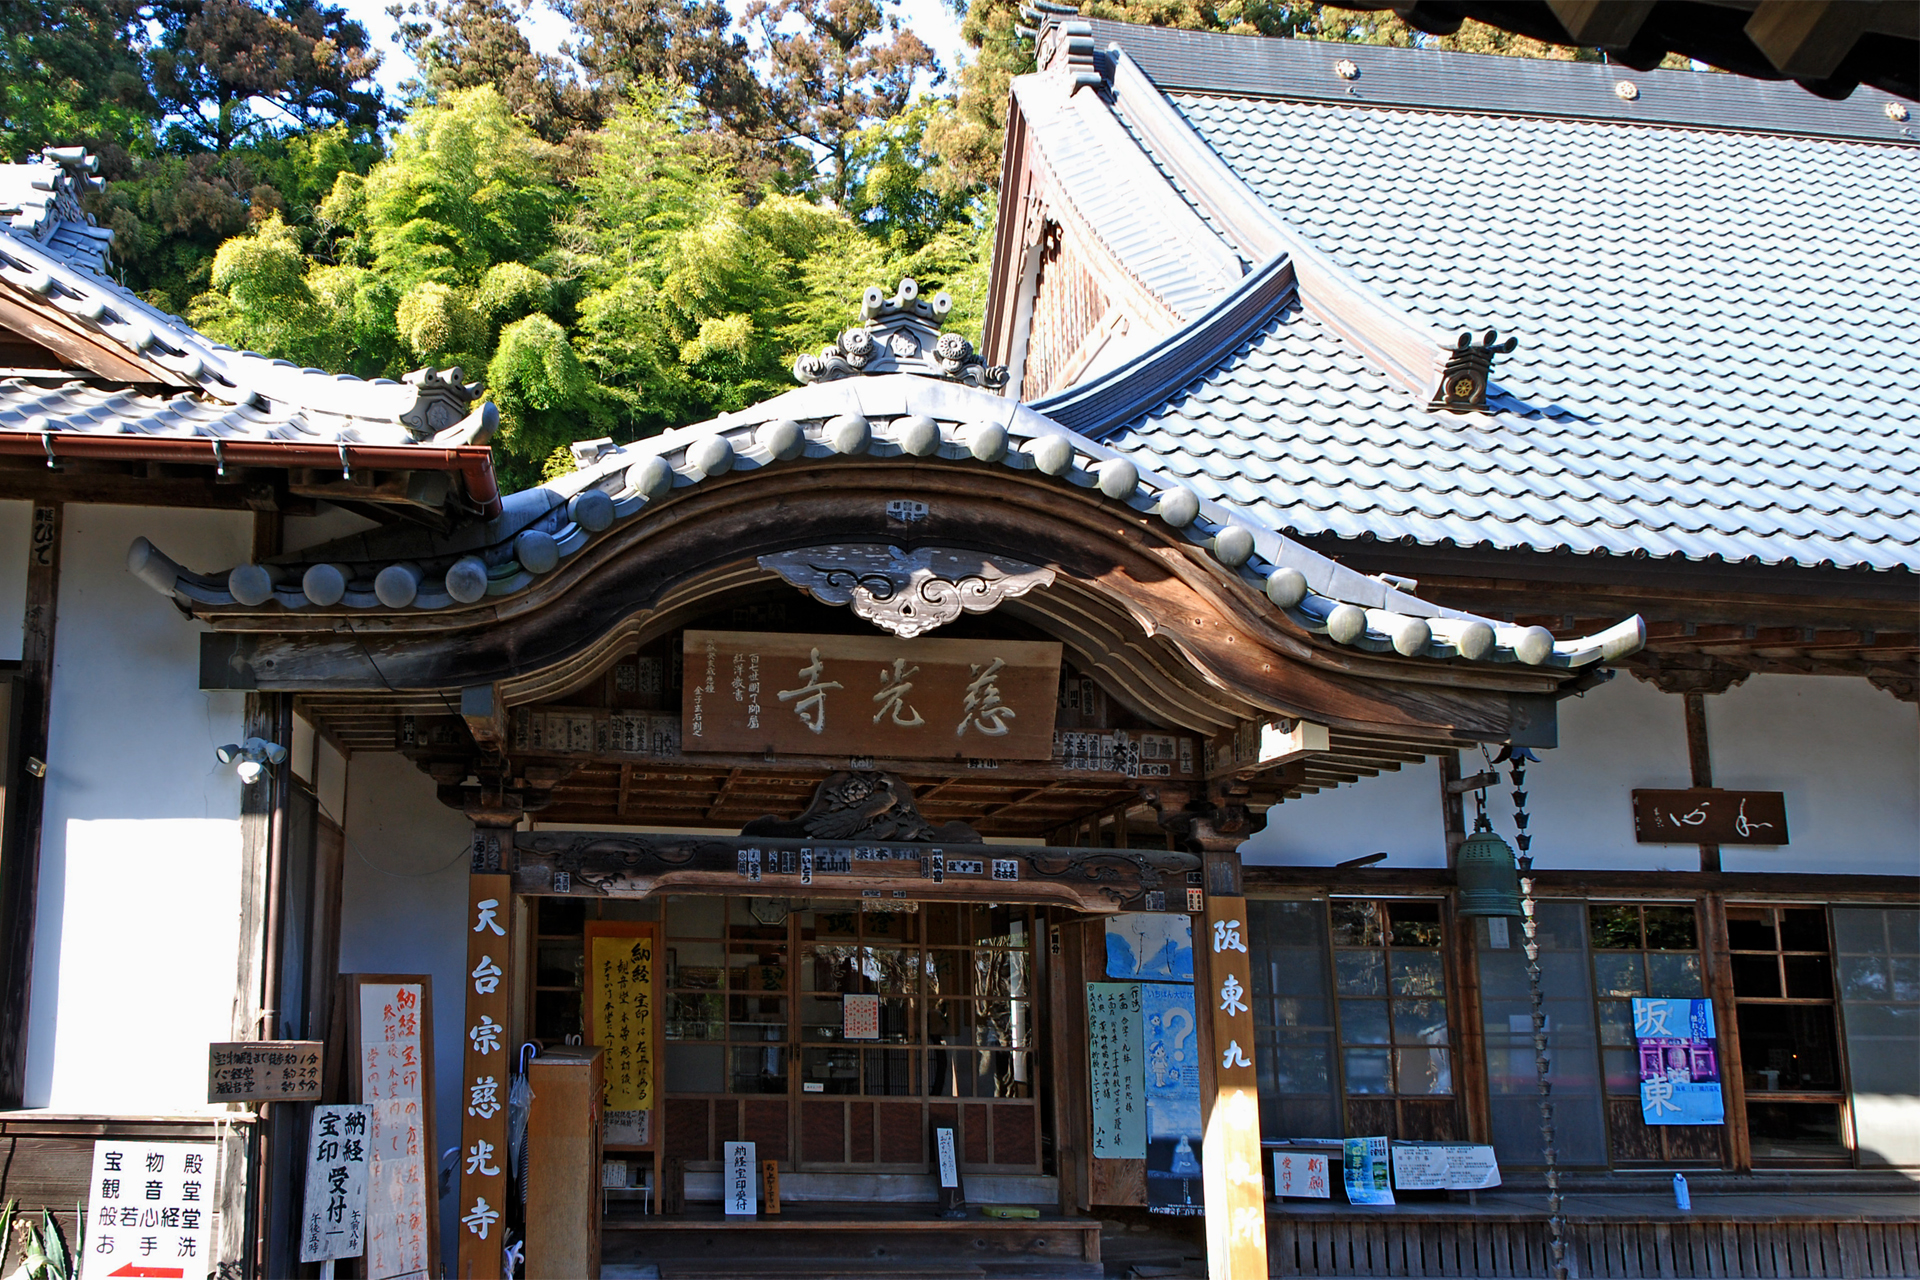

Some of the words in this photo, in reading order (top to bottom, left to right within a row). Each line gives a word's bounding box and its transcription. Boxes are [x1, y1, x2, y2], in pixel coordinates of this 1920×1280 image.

[777, 647, 1017, 738] 慈光寺
[1127, 754, 1138, 777] 小山
[214, 1067, 255, 1081] 心経堂
[215, 1080, 256, 1094] 観音堂
[462, 898, 506, 1241] 天台宗慈光寺
[316, 1110, 342, 1164] 宝印
[343, 1110, 367, 1163] 納経
[104, 1151, 204, 1174] 宝物殿
[734, 1145, 748, 1211] 納経宝印受付
[1282, 1156, 1292, 1193] 受付中
[1308, 1157, 1324, 1192] 祈願
[102, 1178, 202, 1201] 観音堂
[326, 1166, 350, 1224] 受付
[98, 1206, 202, 1230] 般若心経堂
[308, 1212, 322, 1254] 午後五時
[349, 1209, 362, 1251] 午前八時
[96, 1234, 197, 1258] お手洗
